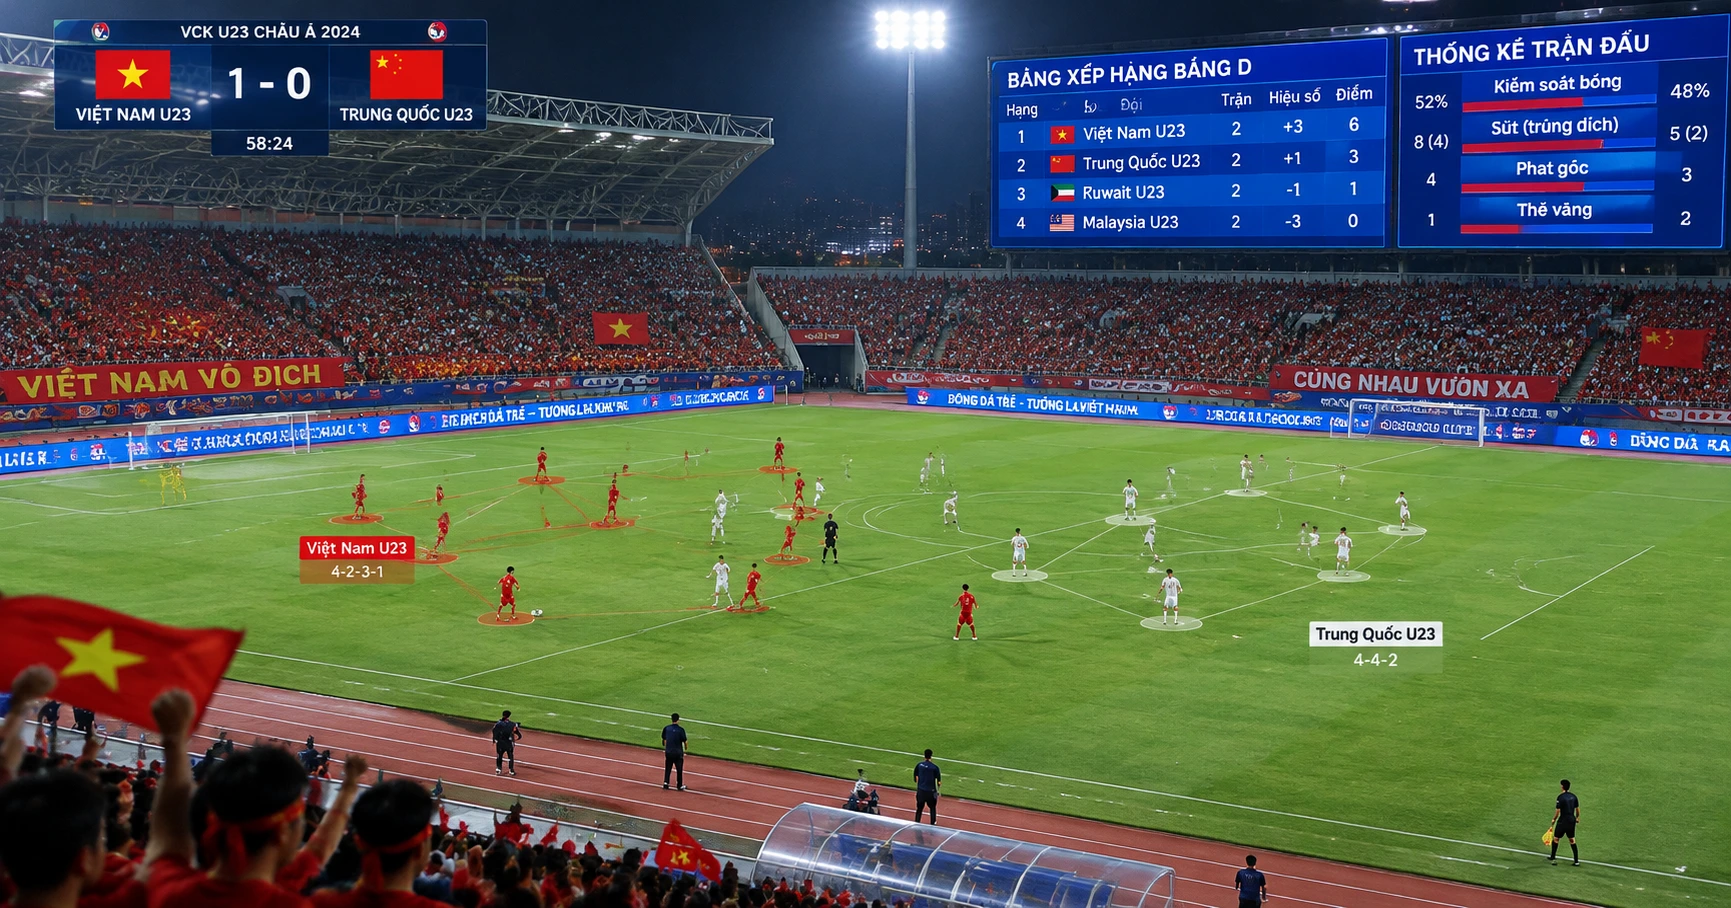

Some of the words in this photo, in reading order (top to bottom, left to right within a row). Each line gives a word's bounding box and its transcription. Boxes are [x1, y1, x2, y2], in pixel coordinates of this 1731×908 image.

[1414, 41, 1489, 65] THỐNG
[1238, 59, 1251, 75] D
[1416, 95, 1448, 109] 52%
[1540, 75, 1575, 91] soát
[1671, 83, 1710, 98] 48%
[1007, 104, 1037, 119] Hạng
[1018, 129, 1024, 144] 1
[1118, 126, 1150, 139] Nam
[1156, 124, 1185, 138] U23
[1231, 121, 1242, 136] 2
[1284, 119, 1302, 133] +3
[1348, 116, 1360, 132] 6
[1413, 134, 1424, 150] 8
[1429, 134, 1448, 150] (4)
[1669, 125, 1681, 141] 5
[1686, 125, 1707, 142] (2)
[1017, 158, 1026, 173] 2
[1083, 157, 1123, 172] Trung
[1172, 154, 1200, 167] U23
[1231, 152, 1241, 167] 2
[1284, 152, 1300, 164] +1
[1348, 148, 1359, 164] 3
[1426, 172, 1437, 187] 4
[1517, 161, 1554, 175] Phat
[1681, 166, 1693, 183] 3
[1017, 186, 1026, 201] 3
[1136, 185, 1164, 198] U23
[1231, 183, 1241, 198] 2
[1287, 183, 1300, 196] -1
[1350, 181, 1357, 196] 1
[1016, 216, 1026, 230] 4
[1084, 215, 1145, 232] Malaysia
[1151, 216, 1178, 228] U23
[1231, 214, 1241, 229] 2
[1286, 215, 1300, 228] -3
[1347, 213, 1359, 228] 0
[1428, 213, 1435, 227] 1
[1680, 210, 1692, 226] 2
[110, 370, 188, 395] NAM
[1358, 374, 1418, 393] NHAU
[1495, 381, 1529, 398] XA
